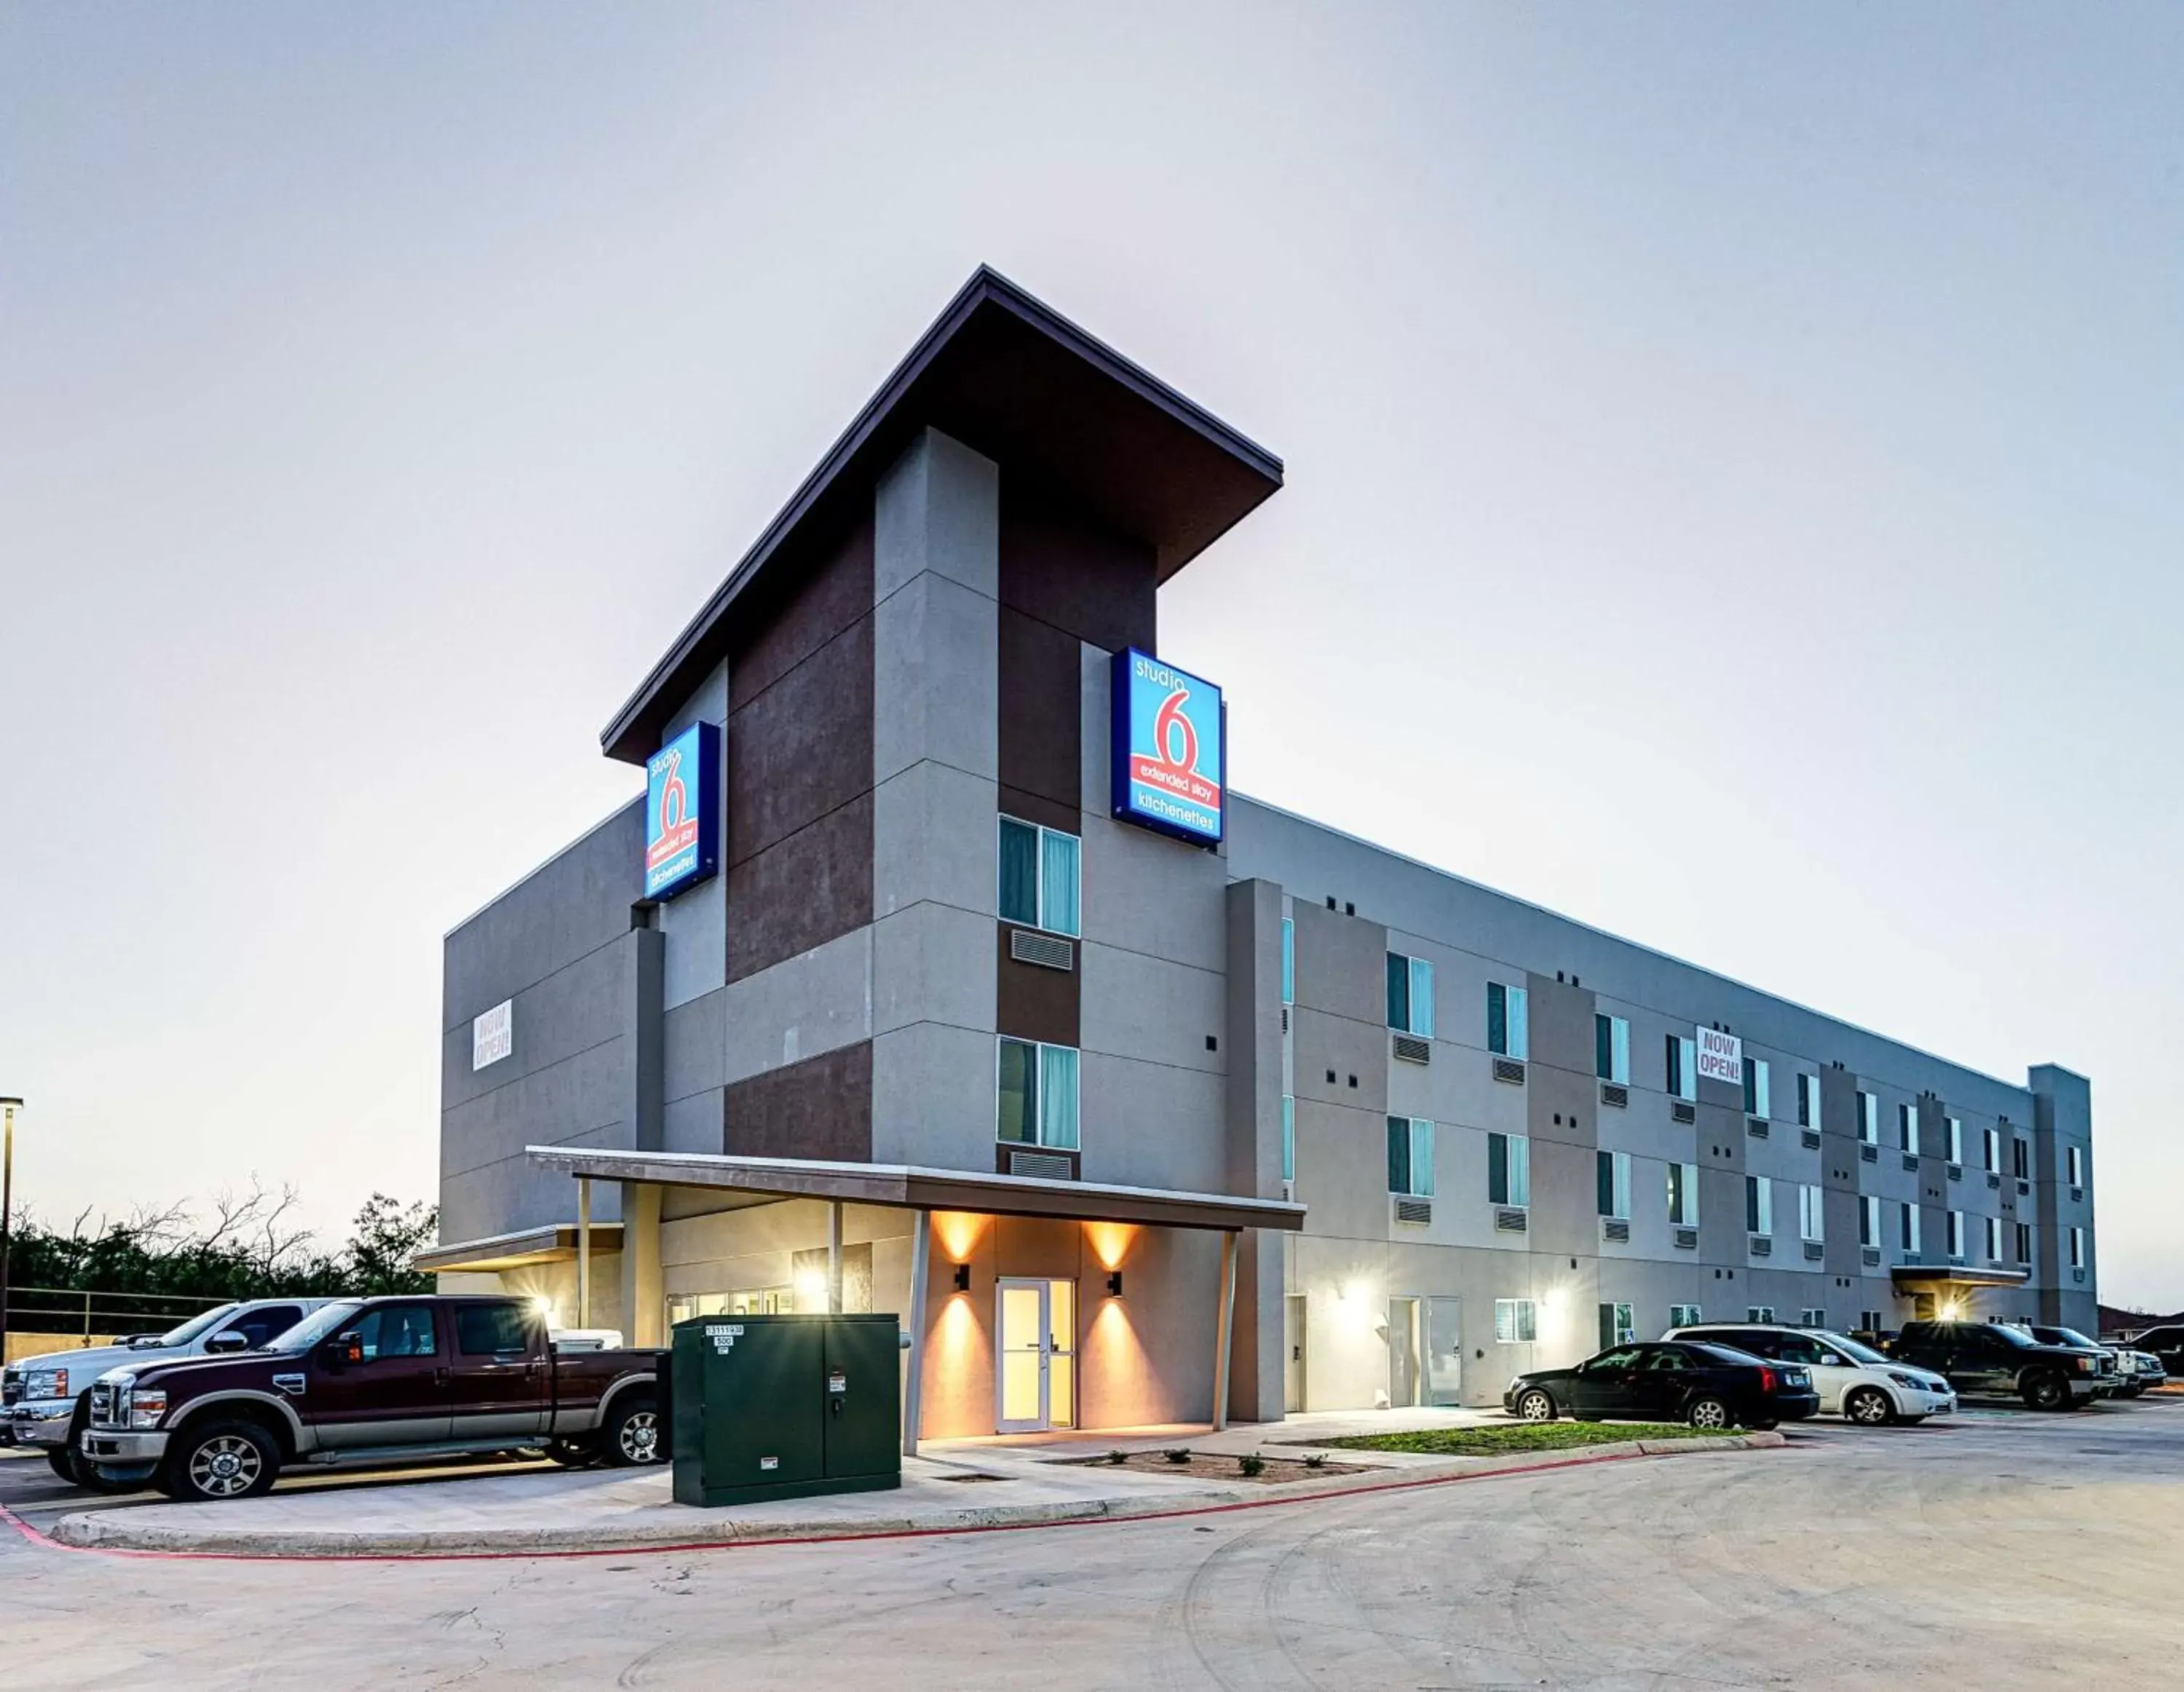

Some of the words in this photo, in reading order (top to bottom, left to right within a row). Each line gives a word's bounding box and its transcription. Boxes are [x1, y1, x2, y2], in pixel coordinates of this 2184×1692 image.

[1136, 660, 1184, 691] studio
[1155, 689, 1198, 773] 6
[660, 749, 686, 836] 6
[1140, 764, 1189, 792] extended
[1192, 783, 1212, 802] stay
[1138, 791, 1214, 830] kitchenettes
[1704, 1031, 1735, 1056] NOW
[1700, 1053, 1739, 1080] OPEN!
